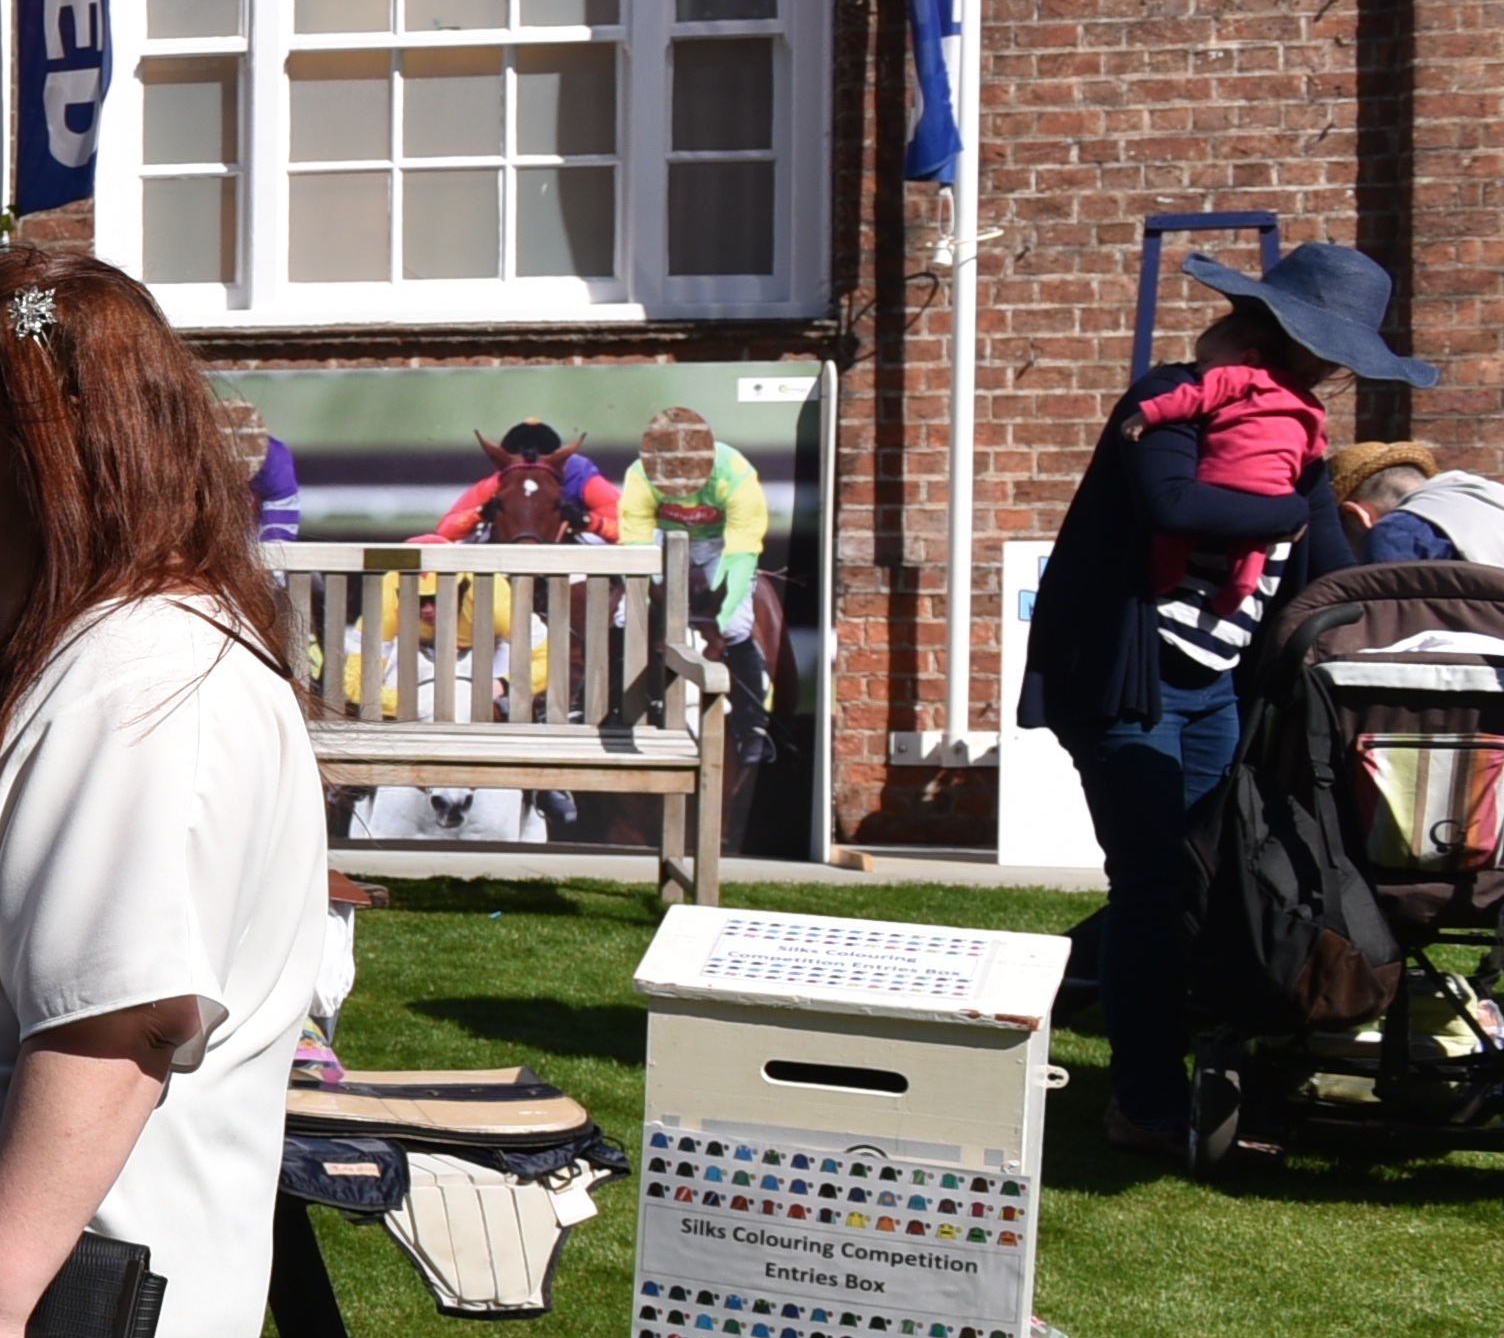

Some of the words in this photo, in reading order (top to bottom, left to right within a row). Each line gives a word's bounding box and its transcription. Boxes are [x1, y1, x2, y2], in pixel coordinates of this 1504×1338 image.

[727, 951, 846, 967] Competition
[852, 962, 918, 974] Entries
[925, 969, 961, 977] Box
[777, 945, 819, 954] Silks
[826, 949, 917, 963] Colouring
[680, 1218, 727, 1241] Silks
[732, 1225, 835, 1259] Colouring
[841, 1241, 978, 1275] Competition
[764, 1261, 839, 1289] Entries
[844, 1273, 886, 1295] Box
